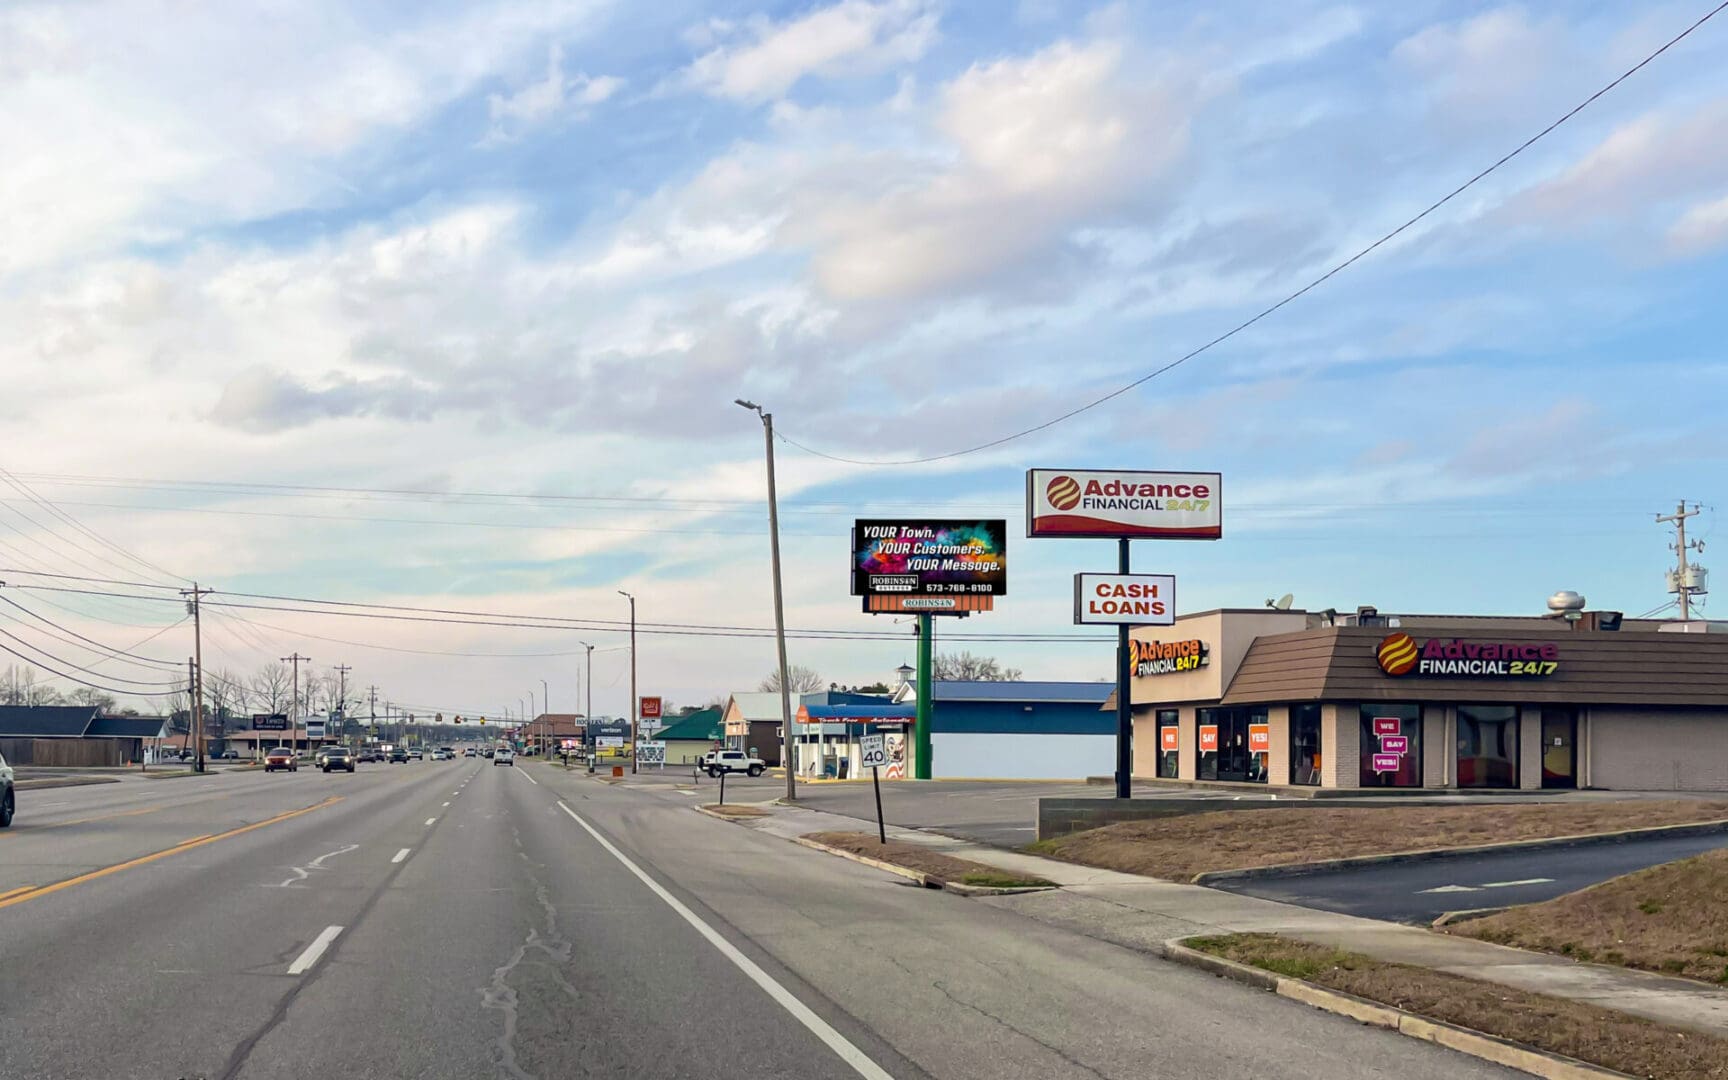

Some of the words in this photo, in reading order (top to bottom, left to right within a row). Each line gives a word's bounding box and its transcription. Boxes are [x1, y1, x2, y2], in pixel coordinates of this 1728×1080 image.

[1084, 480, 1209, 498] Advance
[1083, 498, 1164, 511] FINANCIAL
[1166, 499, 1210, 512] 24/7
[864, 526, 897, 538] YOUR
[901, 526, 935, 538] Town.
[879, 542, 911, 555] YOUR
[913, 542, 985, 555] Customers.
[907, 559, 938, 571] YOUR
[941, 559, 1000, 573] Message.
[1096, 583, 1158, 598] CASH
[1089, 600, 1165, 616] LOANS
[1140, 640, 1199, 659] Advance
[1422, 639, 1559, 659] Advance
[1138, 659, 1176, 675] FINANCIAL
[1176, 655, 1199, 671] 24/7
[1419, 660, 1507, 674] FINANCIAL
[1509, 661, 1558, 675] 24/7
[1380, 722, 1395, 730] WE
[862, 736, 882, 744] SPEED
[1165, 734, 1175, 743] WE
[1202, 733, 1216, 743] SAY
[1252, 732, 1268, 743] YES!
[864, 743, 881, 751] LIMIT
[863, 751, 884, 763] 40
